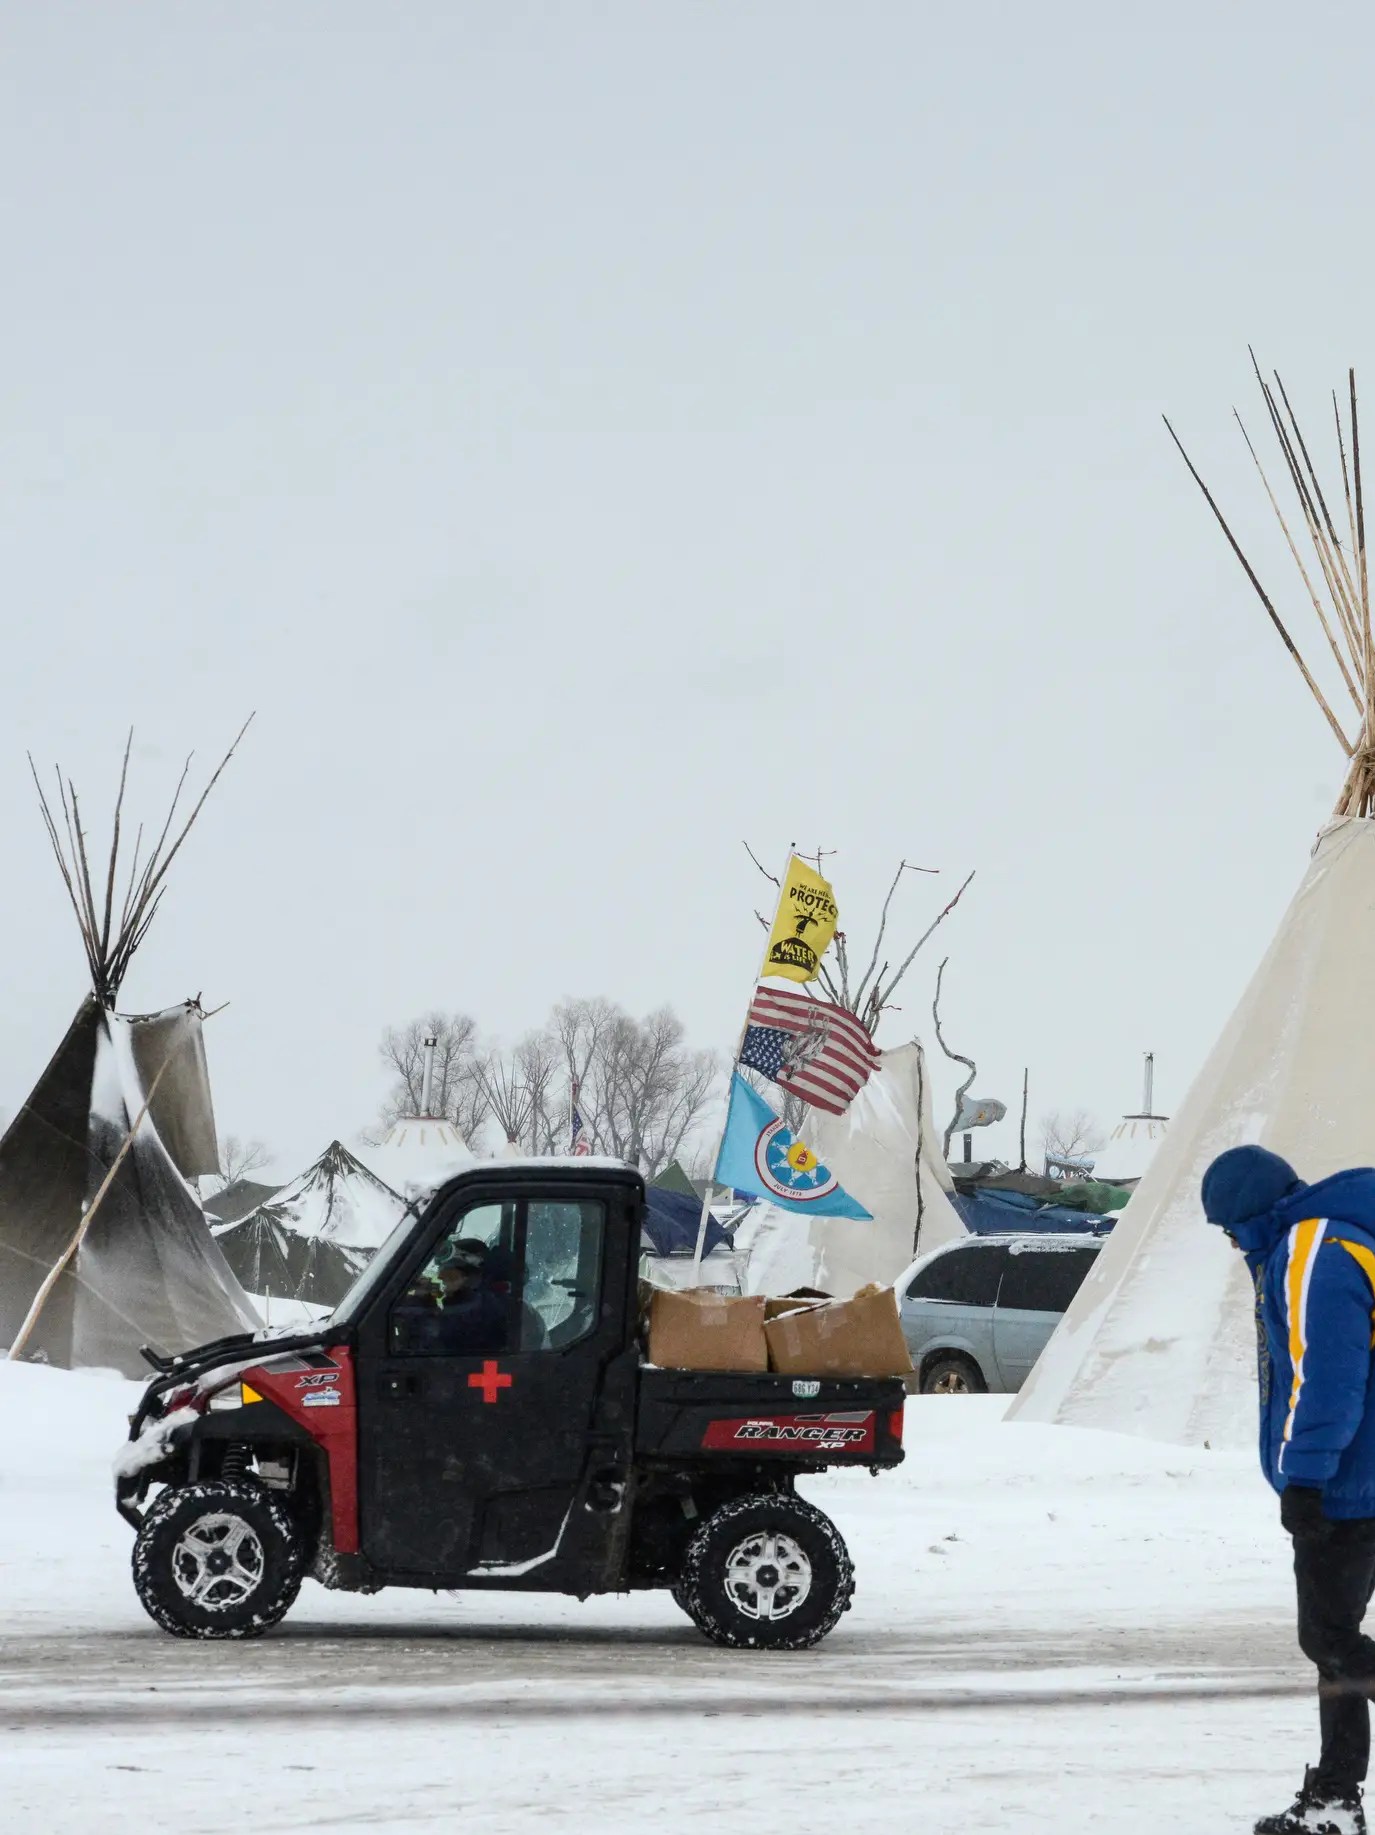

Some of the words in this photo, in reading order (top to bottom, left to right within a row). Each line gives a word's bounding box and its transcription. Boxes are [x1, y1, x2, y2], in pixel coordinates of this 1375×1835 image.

[781, 941, 814, 962] WATER
[774, 1184, 788, 1193] JULY
[294, 1373, 340, 1388] XP
[734, 1425, 867, 1441] RANGER
[816, 1441, 846, 1449] XP
